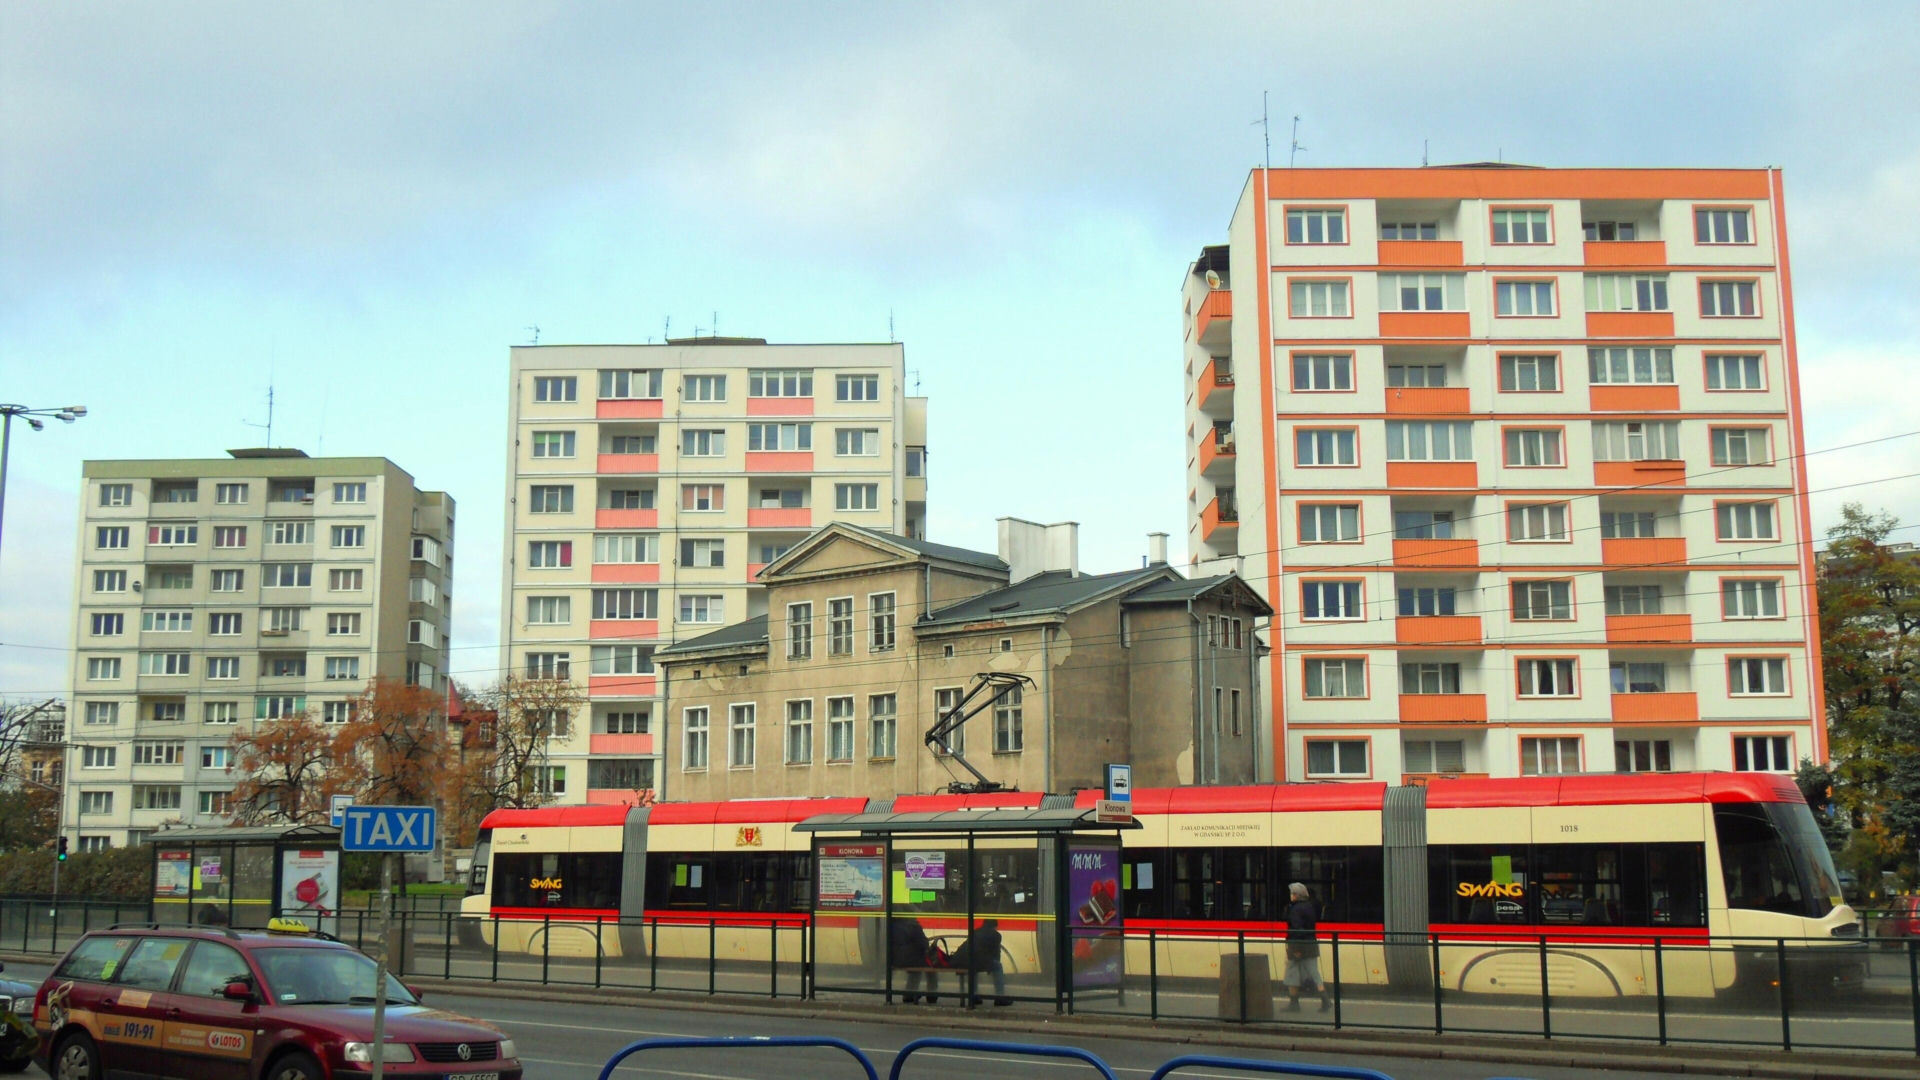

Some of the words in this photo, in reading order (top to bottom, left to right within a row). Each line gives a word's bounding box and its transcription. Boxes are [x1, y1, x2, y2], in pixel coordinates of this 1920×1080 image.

[1104, 803, 1126, 813] Klonowa
[348, 812, 430, 846] TAXI
[124, 1022, 154, 1040] 191-91
[219, 1036, 241, 1048] LOTOS
